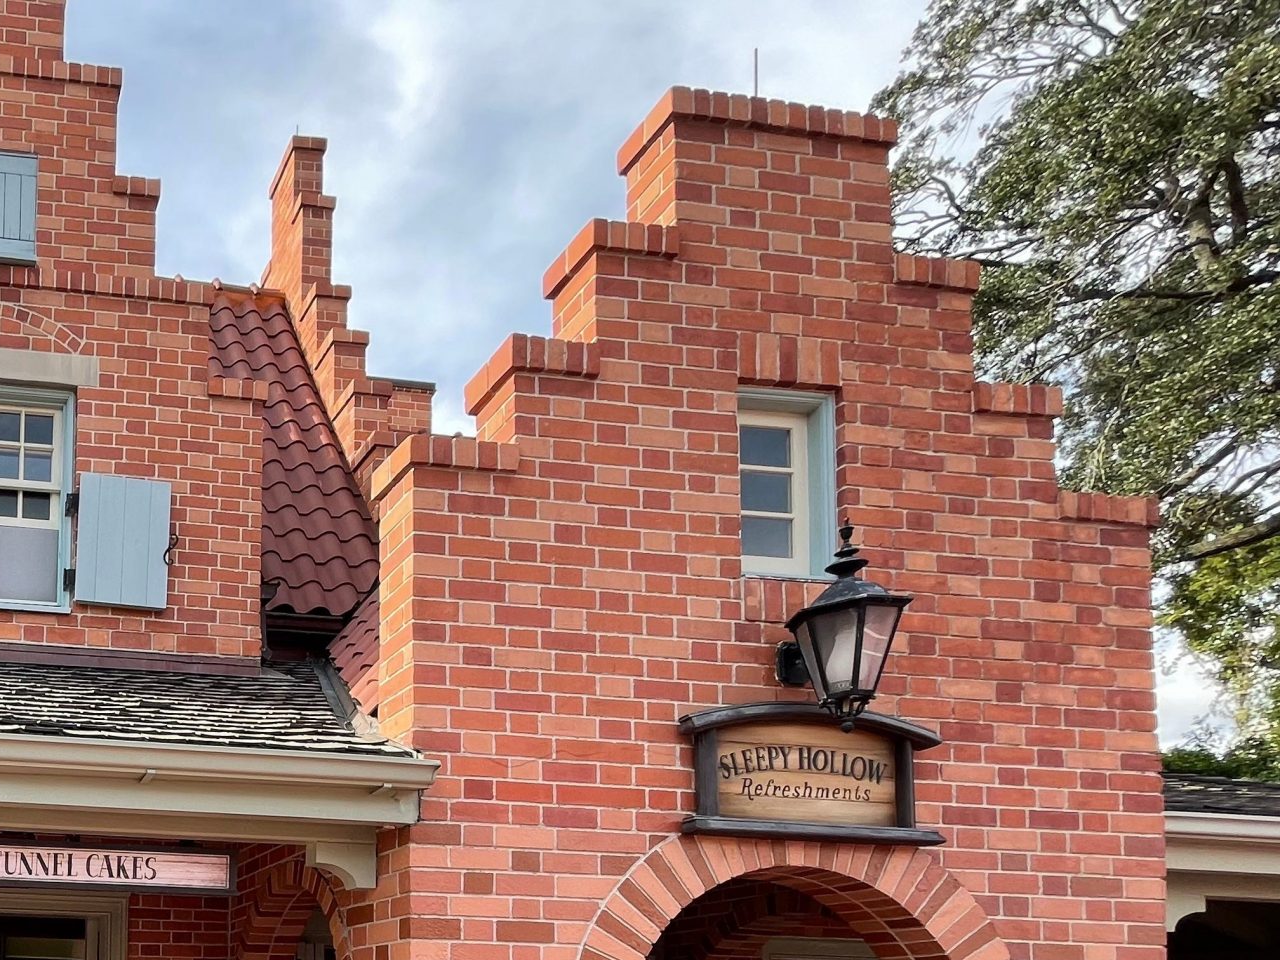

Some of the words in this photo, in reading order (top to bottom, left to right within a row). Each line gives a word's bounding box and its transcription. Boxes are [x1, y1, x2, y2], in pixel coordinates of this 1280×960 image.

[719, 746, 792, 779] SLEEPY
[798, 747, 888, 785] HOLLOW
[741, 777, 871, 801] Refreshments
[86, 853, 157, 880] CAKES
